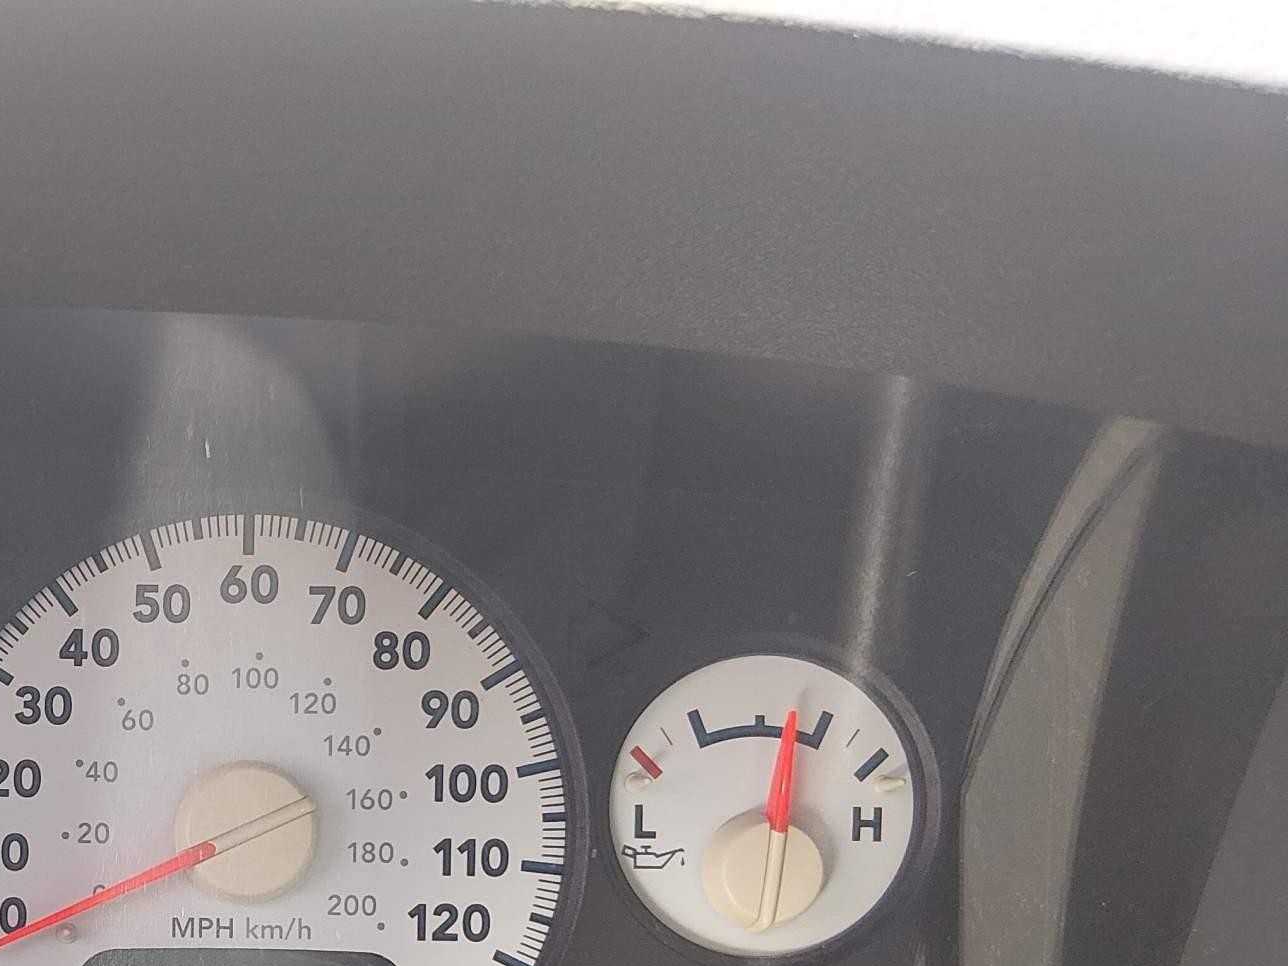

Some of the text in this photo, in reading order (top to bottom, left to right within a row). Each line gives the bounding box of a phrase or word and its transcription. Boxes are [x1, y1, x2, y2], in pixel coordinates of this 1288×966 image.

[220, 565, 278, 604] 60
[133, 584, 190, 623] 50
[309, 586, 366, 625] 70
[59, 629, 119, 667] 40
[373, 631, 430, 670] 80
[177, 674, 208, 695] 80
[232, 668, 278, 689] 100
[14, 685, 72, 725] 30
[120, 708, 153, 730] 60
[290, 693, 336, 714] 120
[422, 689, 479, 729] 90
[324, 734, 371, 756] 140
[84, 760, 117, 782] 40
[426, 764, 508, 803] 100
[347, 789, 392, 810] 160
[78, 823, 109, 843] 20
[635, 805, 656, 839] L
[852, 807, 882, 841] H
[348, 842, 393, 863] 180
[433, 839, 509, 877] 110
[328, 895, 376, 916] 200
[172, 917, 311, 940] MPH km/h
[408, 904, 490, 942] 120
